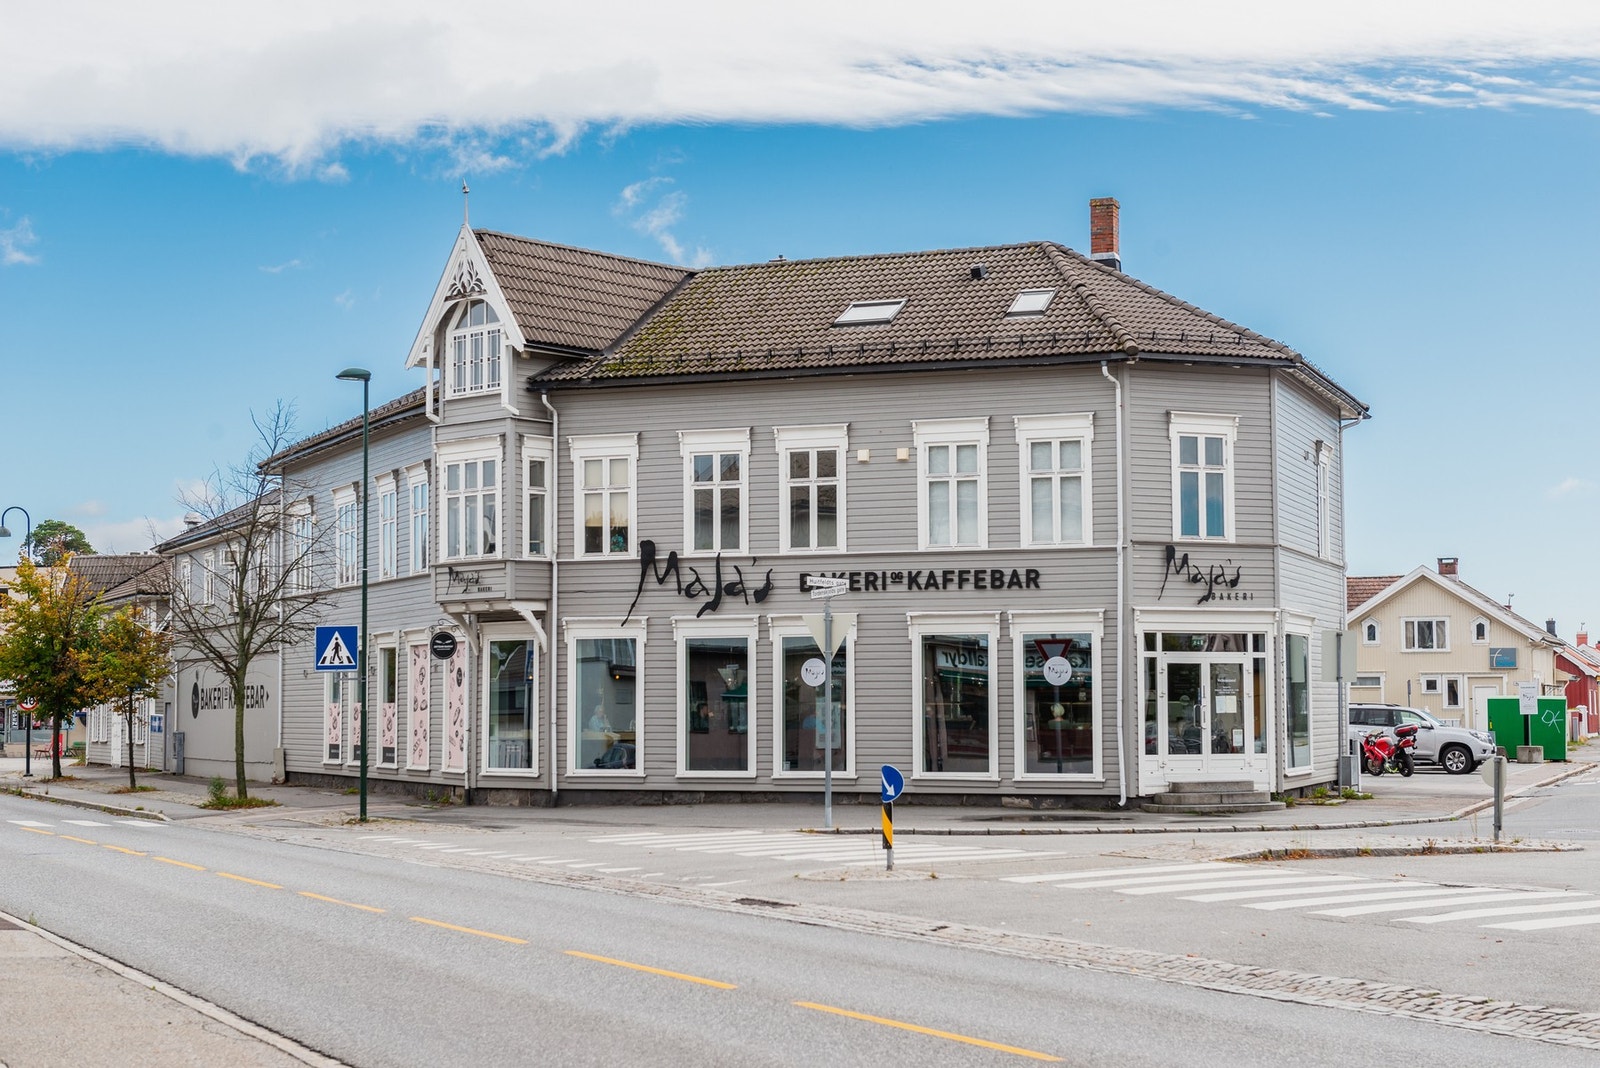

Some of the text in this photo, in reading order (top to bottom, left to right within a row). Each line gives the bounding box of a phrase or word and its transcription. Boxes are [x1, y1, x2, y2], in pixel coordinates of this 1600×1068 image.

[891, 571, 904, 584] OG
[907, 569, 1041, 591] KAFFEBAR
[1211, 593, 1254, 601] BAKERI
[200, 687, 224, 711] BAKERI
